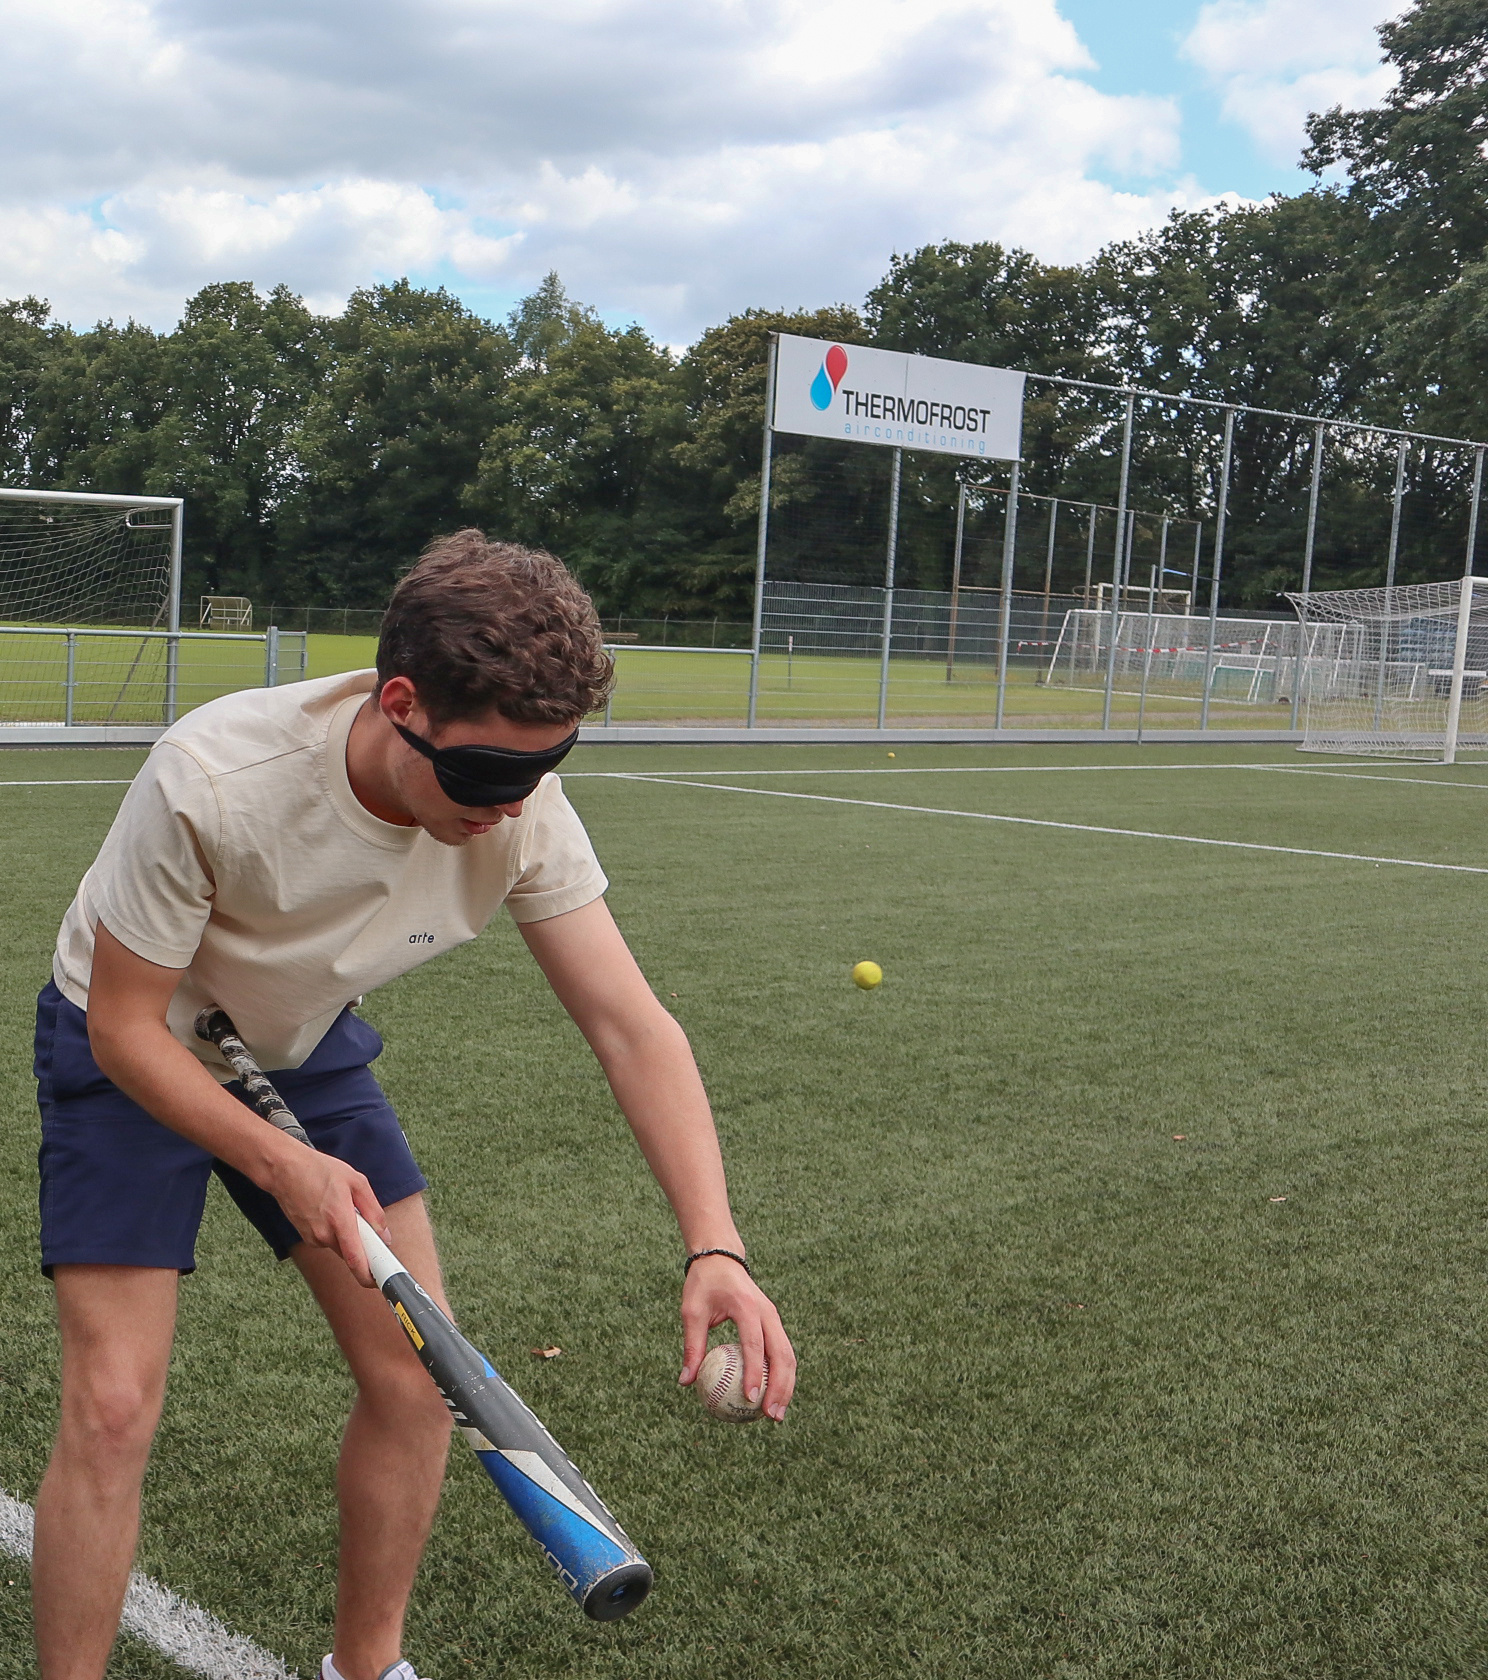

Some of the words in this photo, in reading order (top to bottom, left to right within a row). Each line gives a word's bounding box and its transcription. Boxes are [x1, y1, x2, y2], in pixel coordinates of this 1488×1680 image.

[843, 389, 990, 433] THERMOFROST
[844, 421, 986, 454] airconditioning
[408, 932, 434, 943] arte
[401, 1312, 416, 1335] RICK
